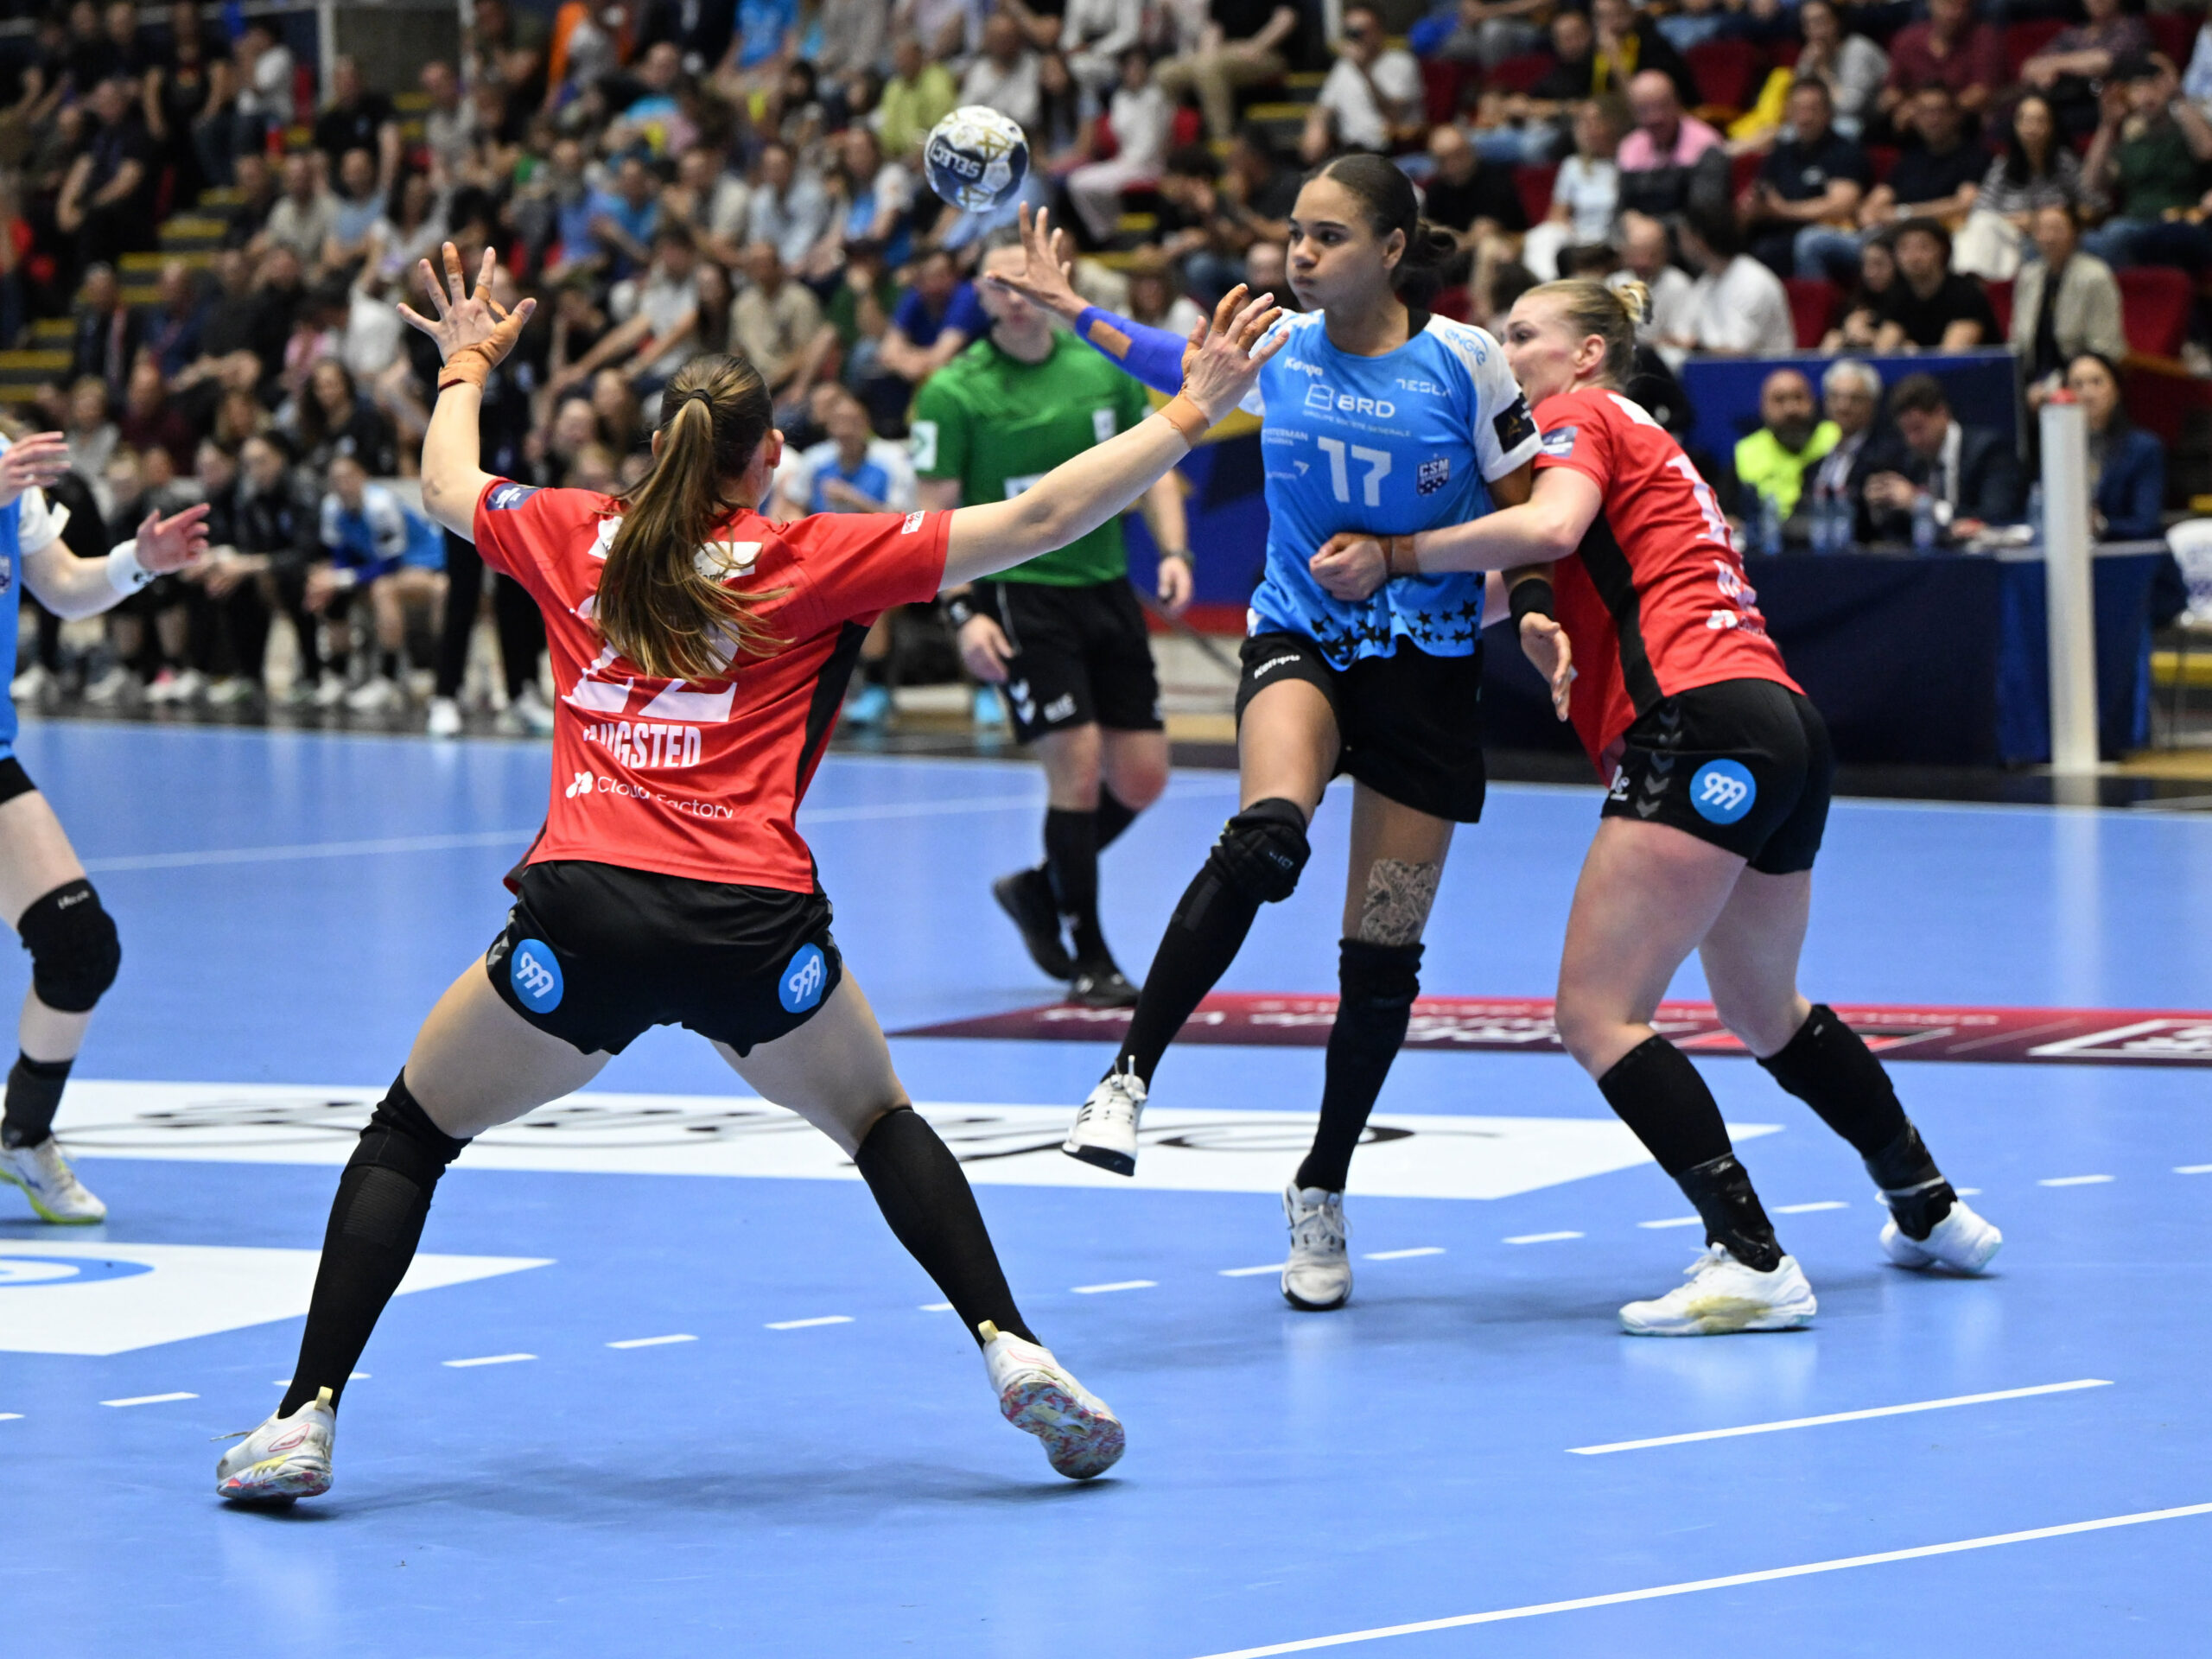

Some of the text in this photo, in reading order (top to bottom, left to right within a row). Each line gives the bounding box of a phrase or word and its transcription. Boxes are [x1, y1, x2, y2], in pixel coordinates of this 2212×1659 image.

[1395, 378, 1452, 398] TESLA
[1338, 394, 1395, 418] BRD
[1318, 435, 1391, 506] 17
[1420, 459, 1449, 477] CSM
[656, 793, 734, 819] actory
